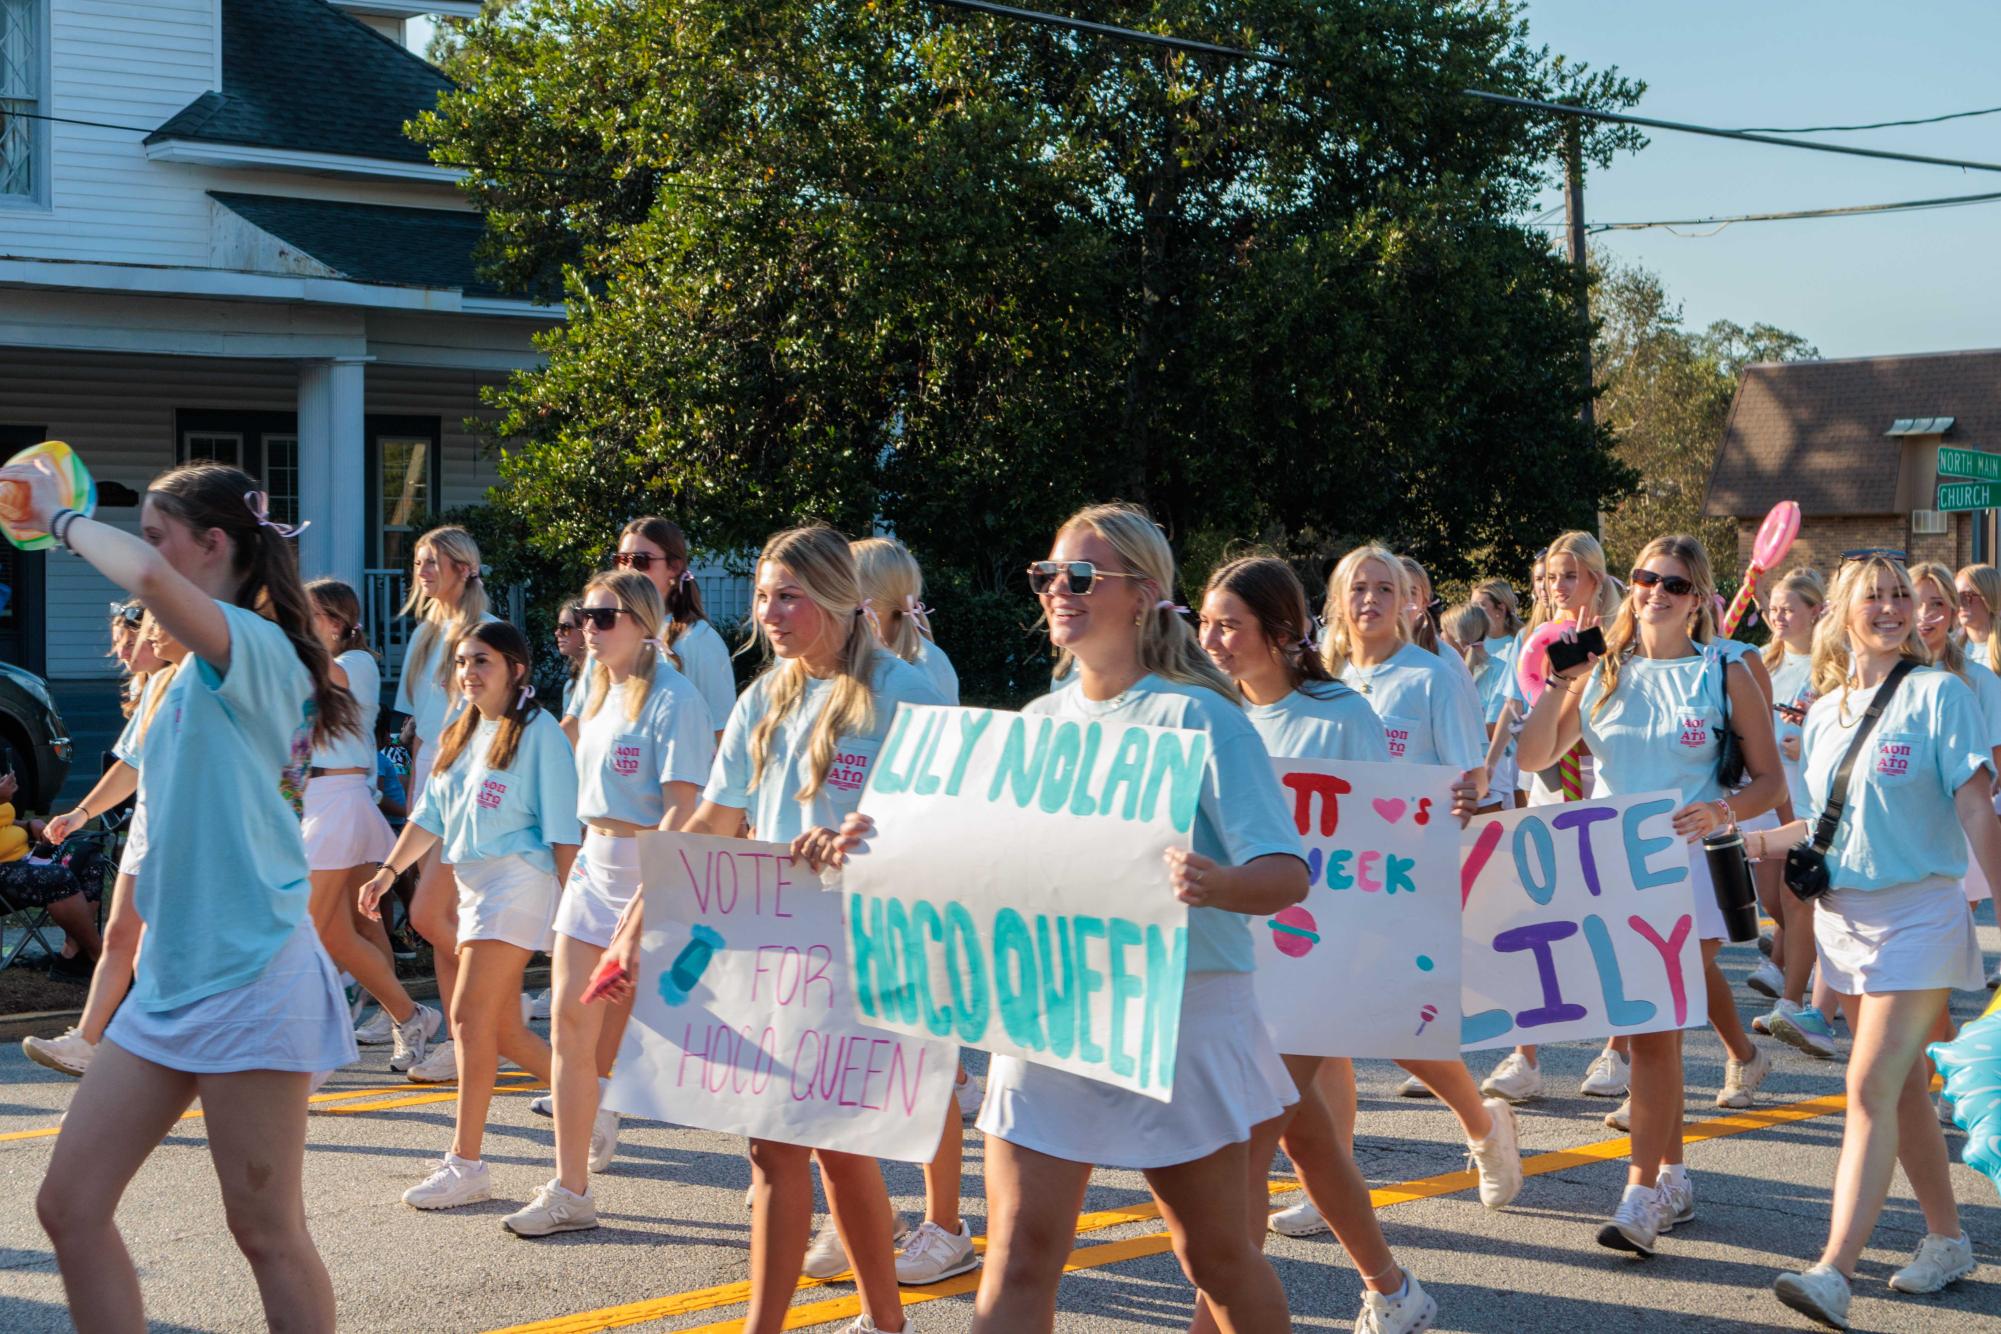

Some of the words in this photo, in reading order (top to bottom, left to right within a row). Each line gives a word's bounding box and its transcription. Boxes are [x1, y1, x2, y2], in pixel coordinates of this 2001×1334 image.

[1940, 451, 1973, 473] NORTH
[1978, 456, 1998, 478] MAIN
[1940, 485, 1990, 508] CHURCH
[872, 708, 993, 796] LILY
[988, 716, 1206, 833] NOLAN
[1389, 742, 1405, 752] ΤΩ
[678, 849, 794, 918] VOTE
[752, 944, 834, 1008] FOR
[850, 892, 990, 1043] HOCO
[993, 907, 1189, 1089] QUEEN
[677, 1023, 775, 1095] HOCO
[790, 1029, 926, 1117] QUEEN
